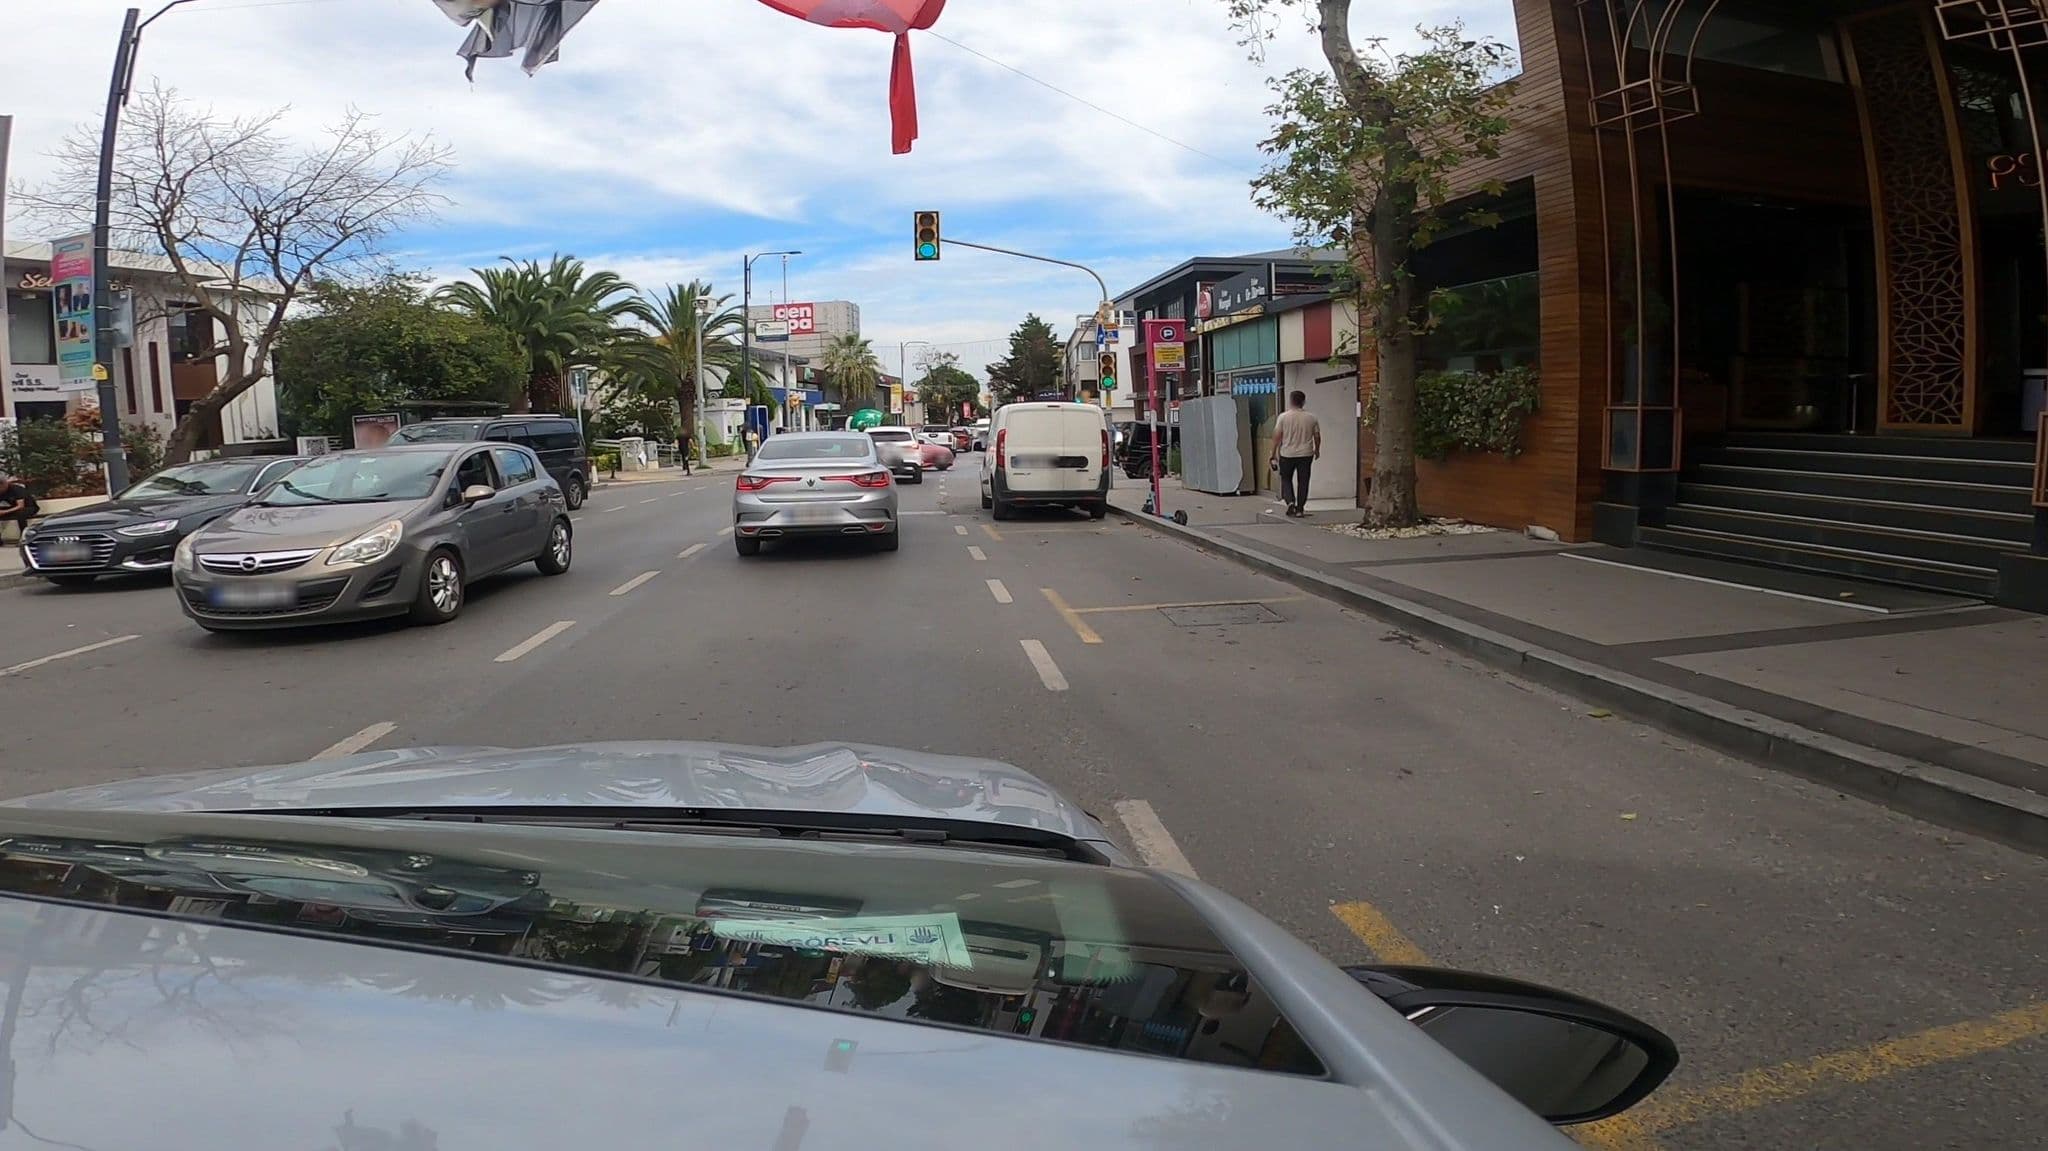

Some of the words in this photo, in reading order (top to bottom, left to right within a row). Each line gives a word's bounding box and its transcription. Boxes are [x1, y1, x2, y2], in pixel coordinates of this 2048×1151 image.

[775, 306, 812, 321] gen
[788, 318, 812, 334] pa
[1163, 328, 1174, 338] P
